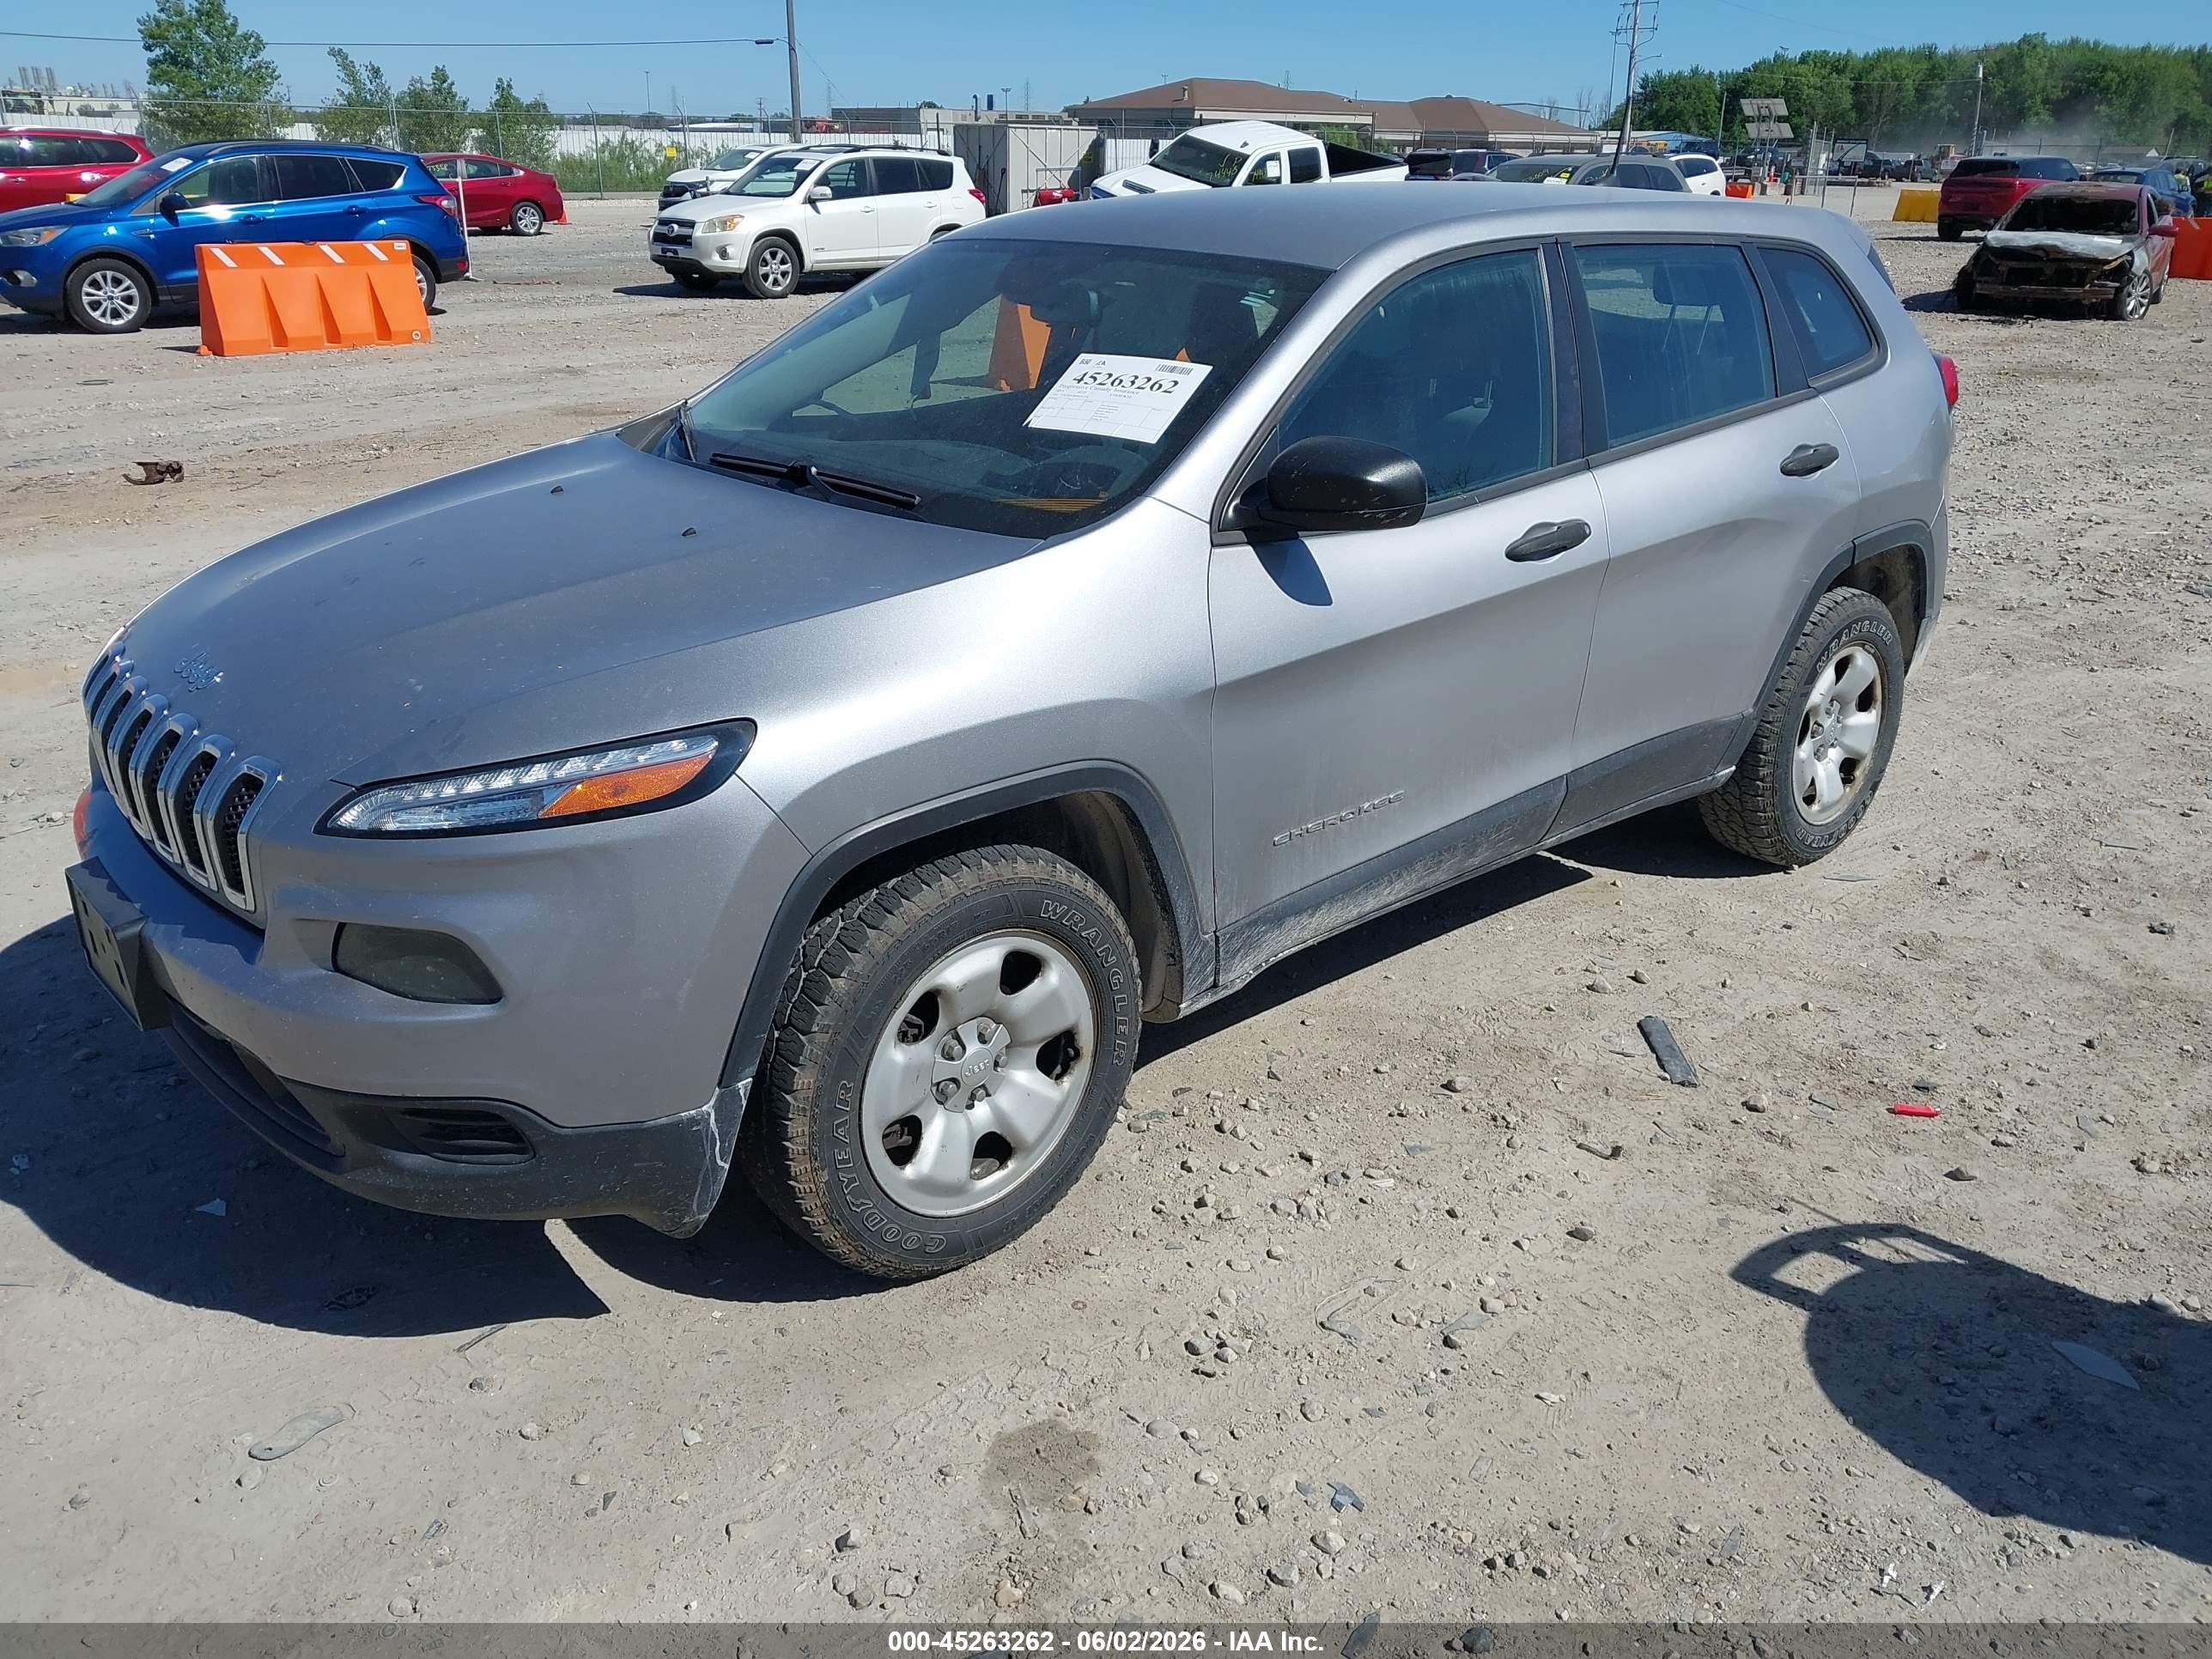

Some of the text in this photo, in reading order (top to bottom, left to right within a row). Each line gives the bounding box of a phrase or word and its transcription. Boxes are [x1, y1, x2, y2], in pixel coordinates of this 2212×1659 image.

[1073, 371, 1179, 394] 45263262
[1815, 620, 1893, 673] WRANGLER
[1273, 790, 1405, 847] CHEROKEE
[1040, 898, 1130, 1067] WRANGLER
[832, 1079, 947, 1255] GOODYEAR
